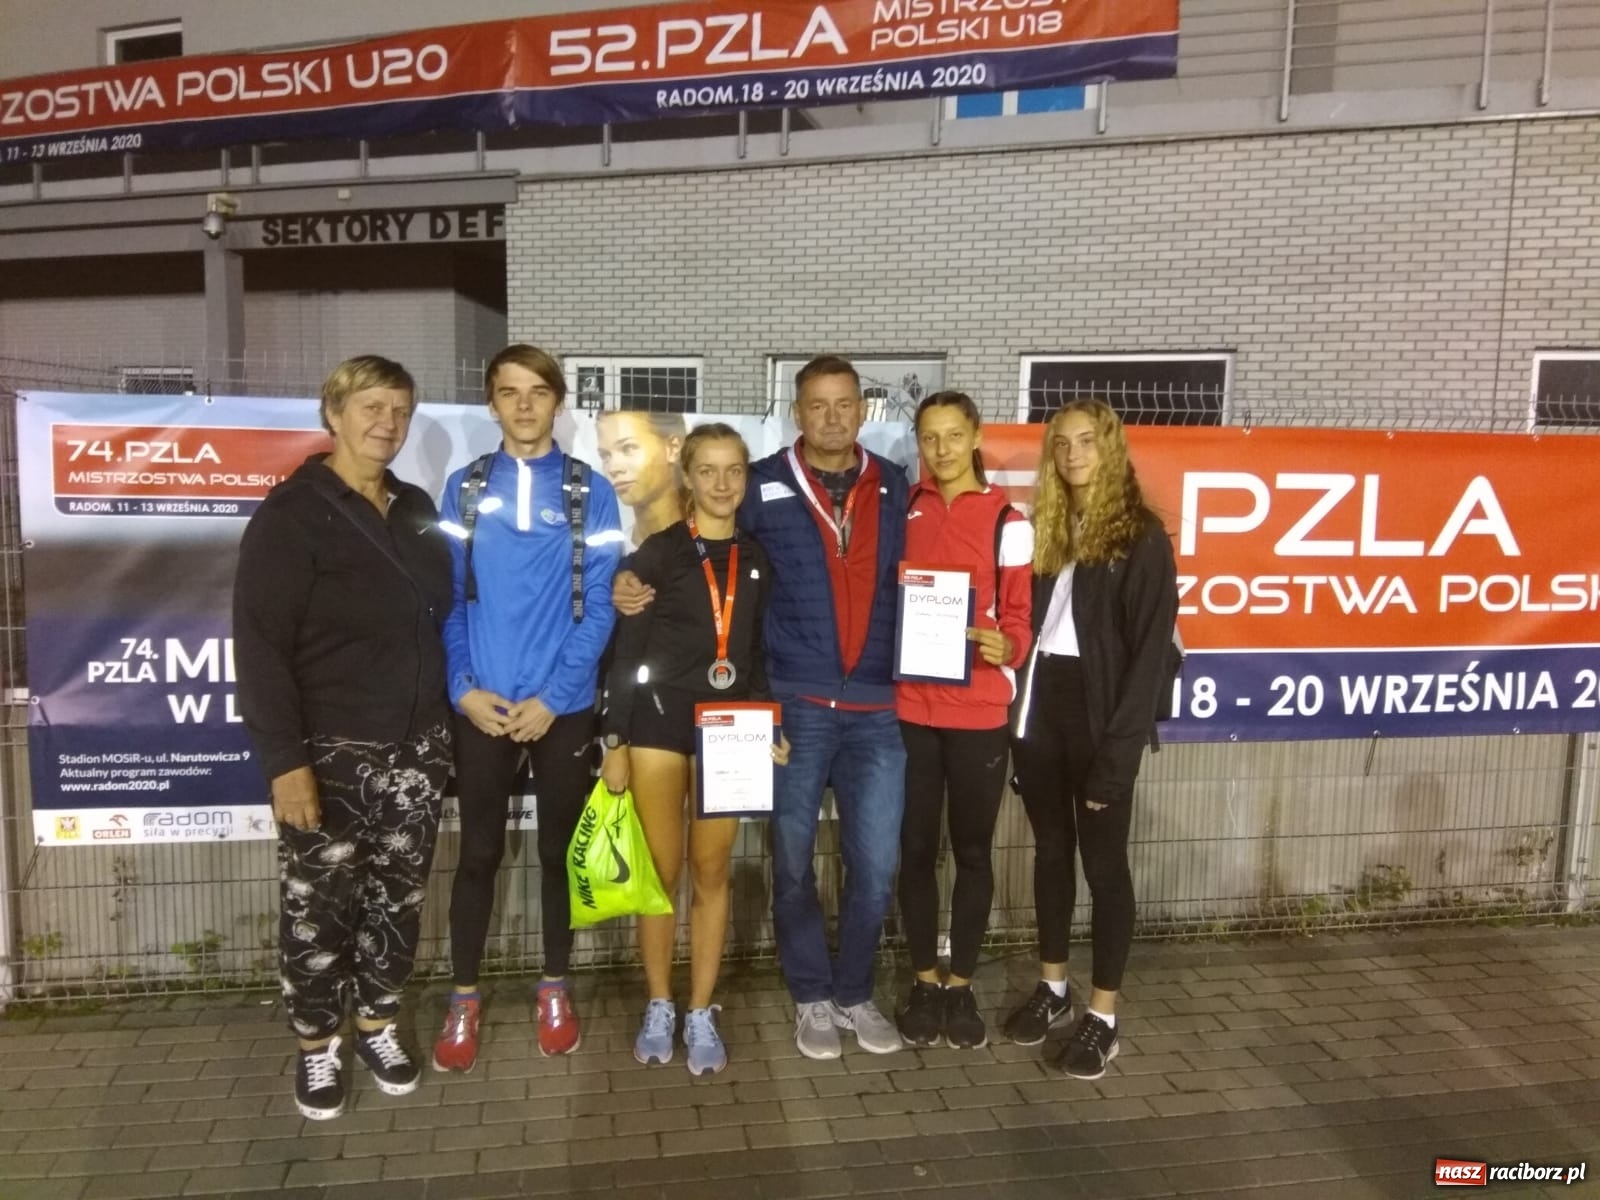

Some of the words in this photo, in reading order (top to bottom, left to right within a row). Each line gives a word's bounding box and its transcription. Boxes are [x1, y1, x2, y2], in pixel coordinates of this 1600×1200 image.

[873, 0, 1066, 24] MISTRZ
[549, 5, 849, 76] 52.PZLA
[871, 17, 988, 50] POLSKI
[1000, 11, 1063, 38] U18
[2, 77, 166, 124] ZOSTWA
[176, 57, 333, 106] POLSKI
[346, 44, 448, 89] U20
[784, 80, 809, 98] 20
[816, 68, 924, 96] WRZEŚNIA
[931, 63, 986, 88] 2020
[8, 146, 19, 160] 11
[32, 144, 45, 158] 13
[48, 134, 107, 157] WRZEŚNIA
[111, 133, 142, 151] 2020
[262, 208, 415, 246] SEKTORY
[66, 440, 221, 464] 74.PZLA
[68, 471, 206, 486] MISTRZOSTWA
[210, 474, 276, 487] POLSKI
[69, 502, 114, 514] RADOM,
[117, 503, 129, 512] 11
[141, 503, 153, 512] 13
[156, 501, 210, 513] WRZEŚNIA
[212, 504, 238, 514] 2020
[1179, 471, 1521, 557] PZLA
[909, 594, 963, 605] DYPLOM
[120, 638, 159, 660] 74.
[88, 661, 157, 683] PZLA
[1171, 676, 1217, 718] 18
[1236, 697, 1251, 707] -
[1267, 675, 1324, 717] 20
[1340, 661, 1559, 715] WRZEŚNIA
[1571, 668, 1600, 709] 2
[167, 694, 211, 724] W
[708, 733, 767, 743] DYPLOM
[59, 754, 100, 764] Stadion
[102, 753, 154, 764] MOSiR-u,
[156, 753, 168, 763] ul.
[171, 751, 240, 763] Narutowicza
[242, 751, 250, 761] 9
[60, 767, 108, 779] Aktualny
[111, 768, 156, 778] program
[158, 766, 212, 776] zawodów:
[61, 780, 169, 791] www.radom2020.pl
[573, 806, 597, 869] RACING
[575, 872, 598, 909] NIKE
